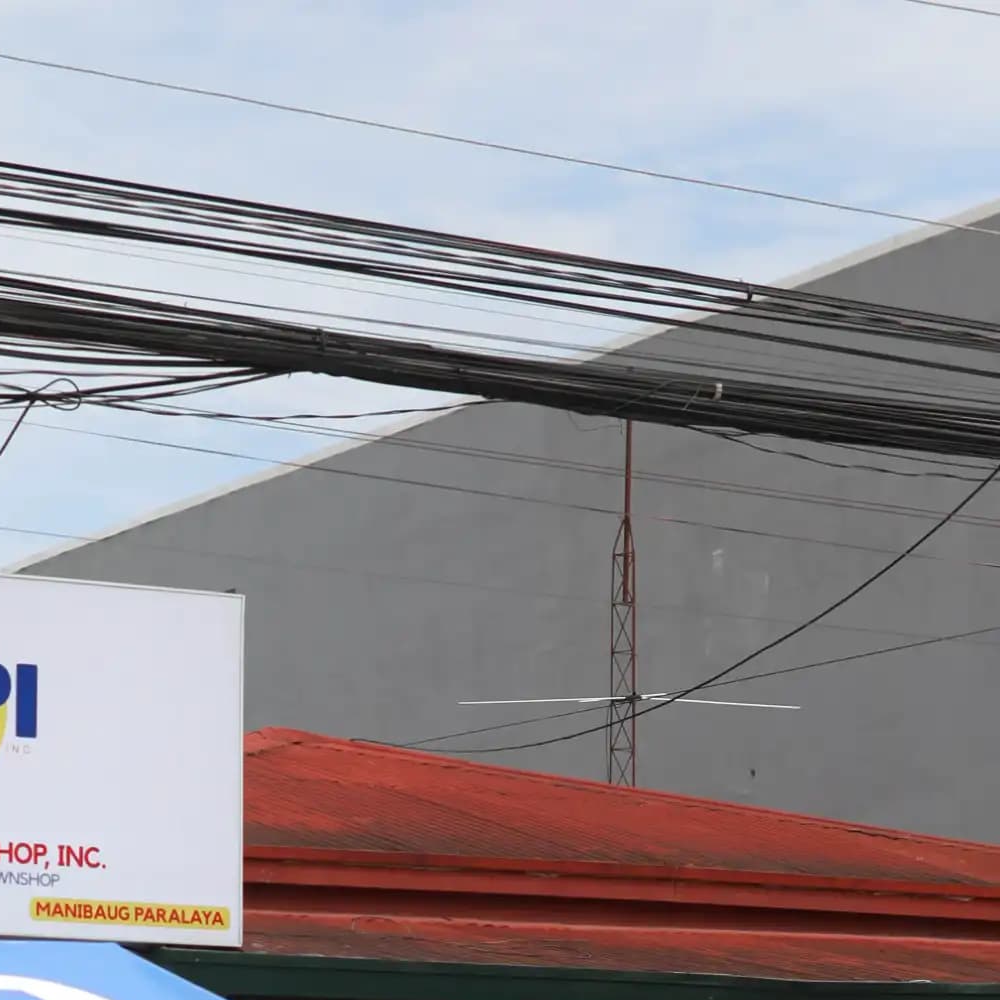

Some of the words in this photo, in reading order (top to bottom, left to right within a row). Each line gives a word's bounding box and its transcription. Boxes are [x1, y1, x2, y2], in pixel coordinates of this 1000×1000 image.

[58, 845, 106, 869] INC.
[36, 902, 130, 921] MANIBAUG
[135, 907, 225, 926] PARALAYA
